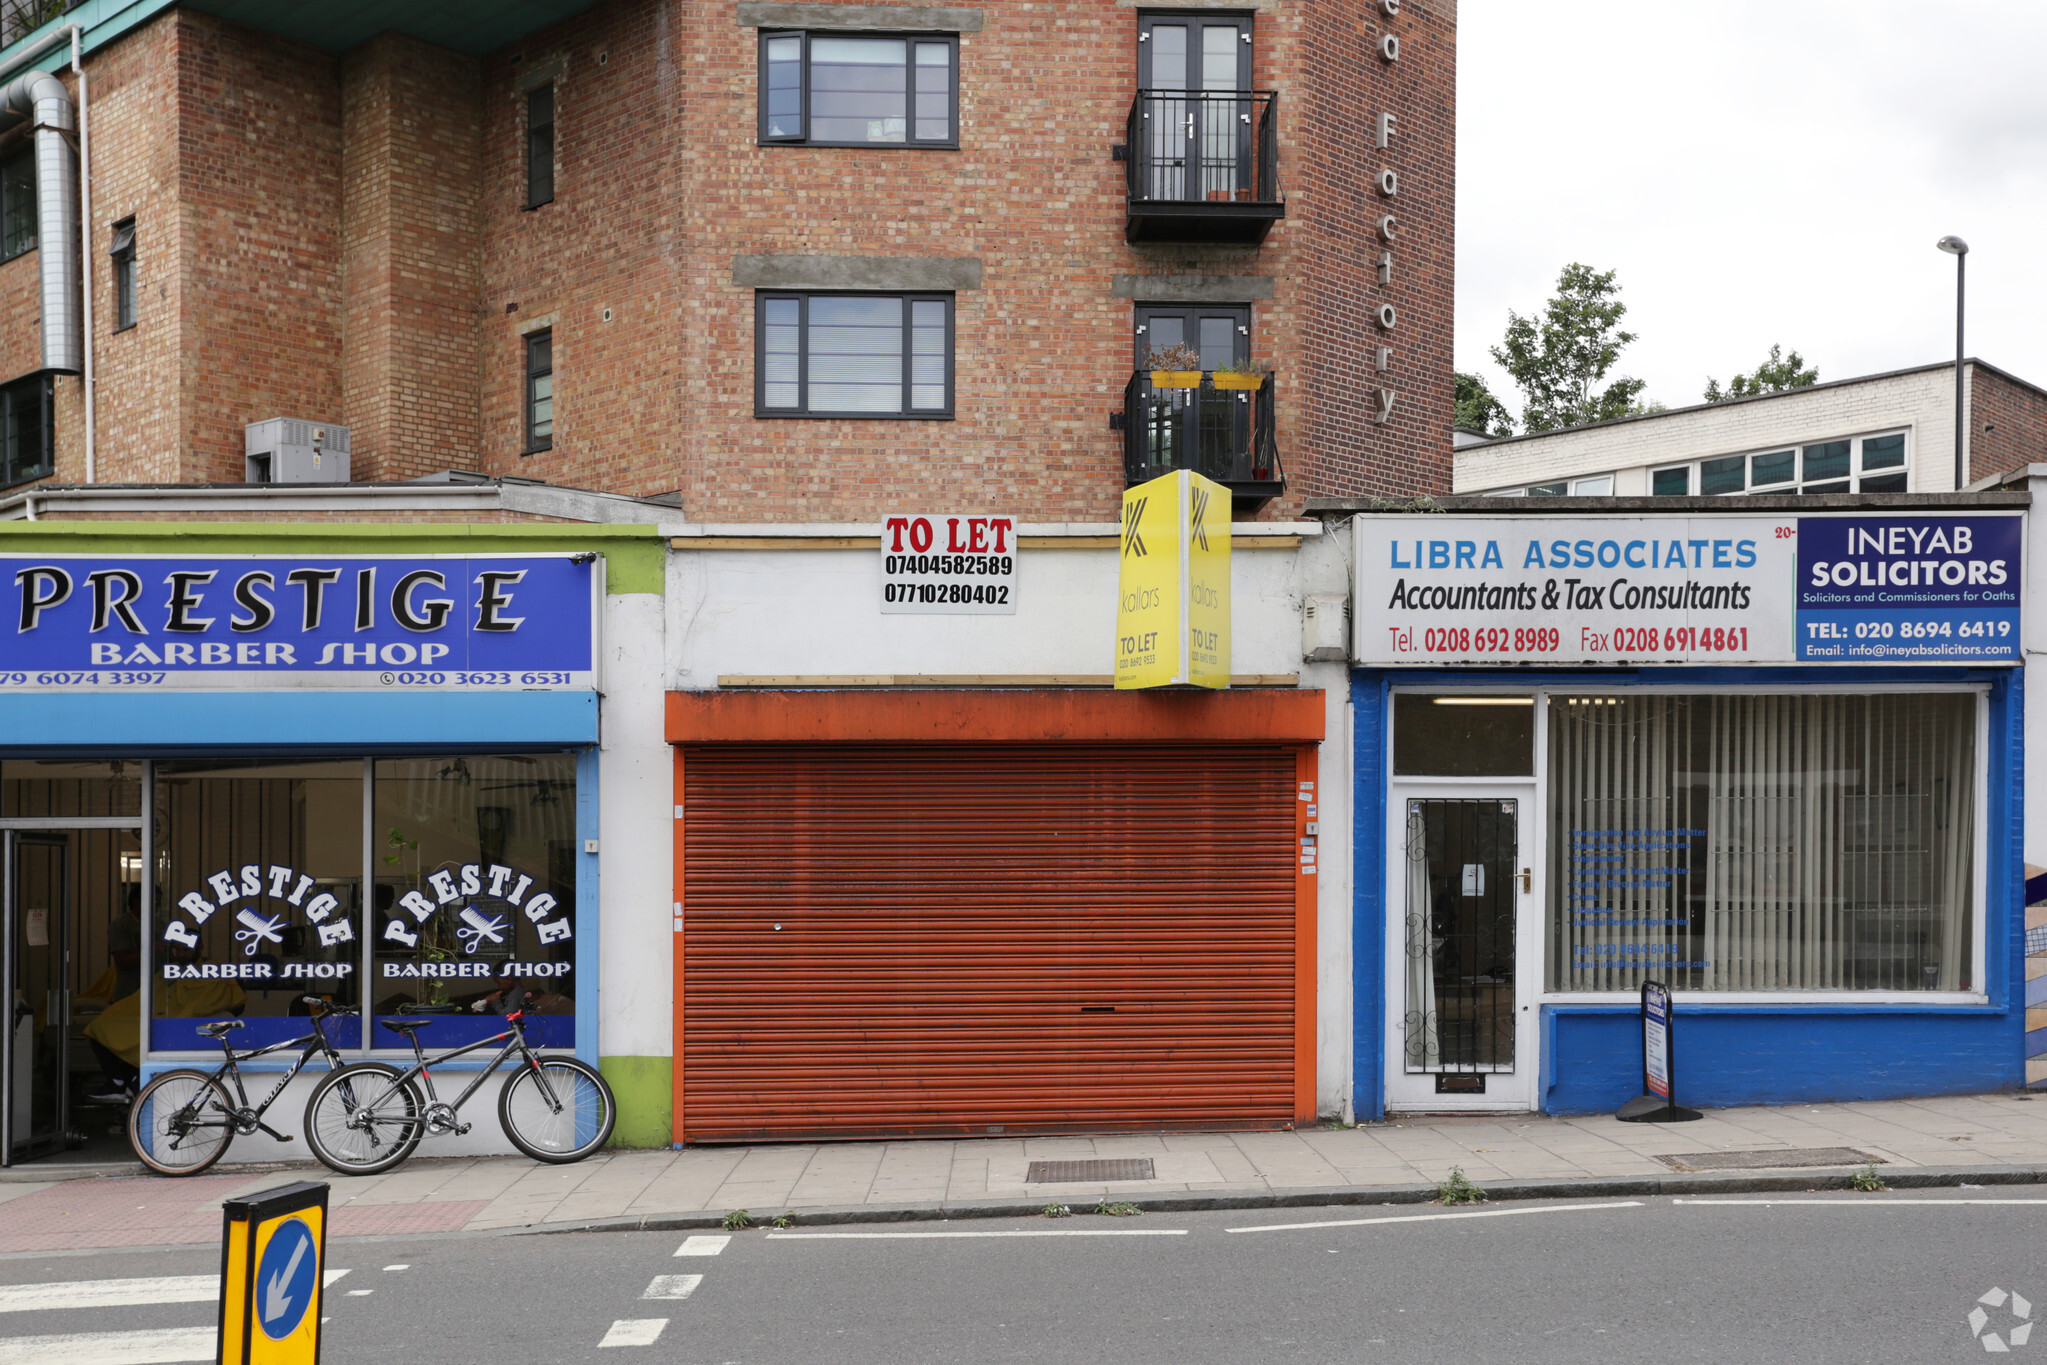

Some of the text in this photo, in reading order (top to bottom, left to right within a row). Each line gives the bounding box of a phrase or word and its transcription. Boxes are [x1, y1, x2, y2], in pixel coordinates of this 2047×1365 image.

[1375, 112, 1397, 426] Factory
[887, 517, 1012, 554] TO LET
[1847, 526, 1973, 556] INEYAB
[1390, 539, 1757, 569] LIBRA ASSOCIATES
[885, 555, 1013, 575] 07404582589
[1811, 560, 2007, 587] SOLICITORS
[14, 566, 529, 635] PRESTIGE
[884, 583, 1009, 604] 07710280402
[1121, 585, 1160, 614] kallars
[1388, 578, 1751, 610] Accountants & Tax Consultants
[1803, 590, 2016, 603] Solicitors and Commissioners for Oaths
[1807, 621, 2011, 639] TEL: 020 8694 6419
[1120, 632, 1158, 655] TO LET
[1192, 628, 1218, 652] TO LET
[1389, 627, 1418, 652] Tel.
[1424, 627, 1469, 652] 0208
[1474, 627, 1509, 652] 692
[1515, 627, 1560, 652] 8989
[1581, 627, 1609, 652] Fax
[1613, 627, 1659, 652] 0208
[90, 642, 450, 666] BARBER SHOP
[1806, 643, 2012, 658] Email: info@ineyabsolicitors.com
[0, 672, 167, 685] 79 6074 3397
[398, 672, 571, 684] 020 3623 6531
[1573, 828, 1707, 838] Immigration and Asylum Matter
[1573, 841, 1690, 851] Same Day Visa Applications
[1573, 854, 1625, 864] Employment
[1573, 867, 1690, 876] Landlord and Tenant Matter
[1573, 880, 1600, 889] Family
[1608, 880, 1640, 888] Divorce
[1643, 880, 1672, 888] Matter
[382, 863, 574, 947] PRESTIGE
[1573, 893, 1597, 901] Crime
[162, 864, 356, 949] PRESTIGE
[1573, 906, 1613, 916] Litigation
[1573, 918, 1689, 927] Judicial Review Application
[1573, 944, 1679, 955] Tel: 020 8694 6419
[163, 963, 352, 979] BARBER SHOP
[383, 962, 571, 978] BARBER SHOP
[1572, 960, 1598, 969] Email:
